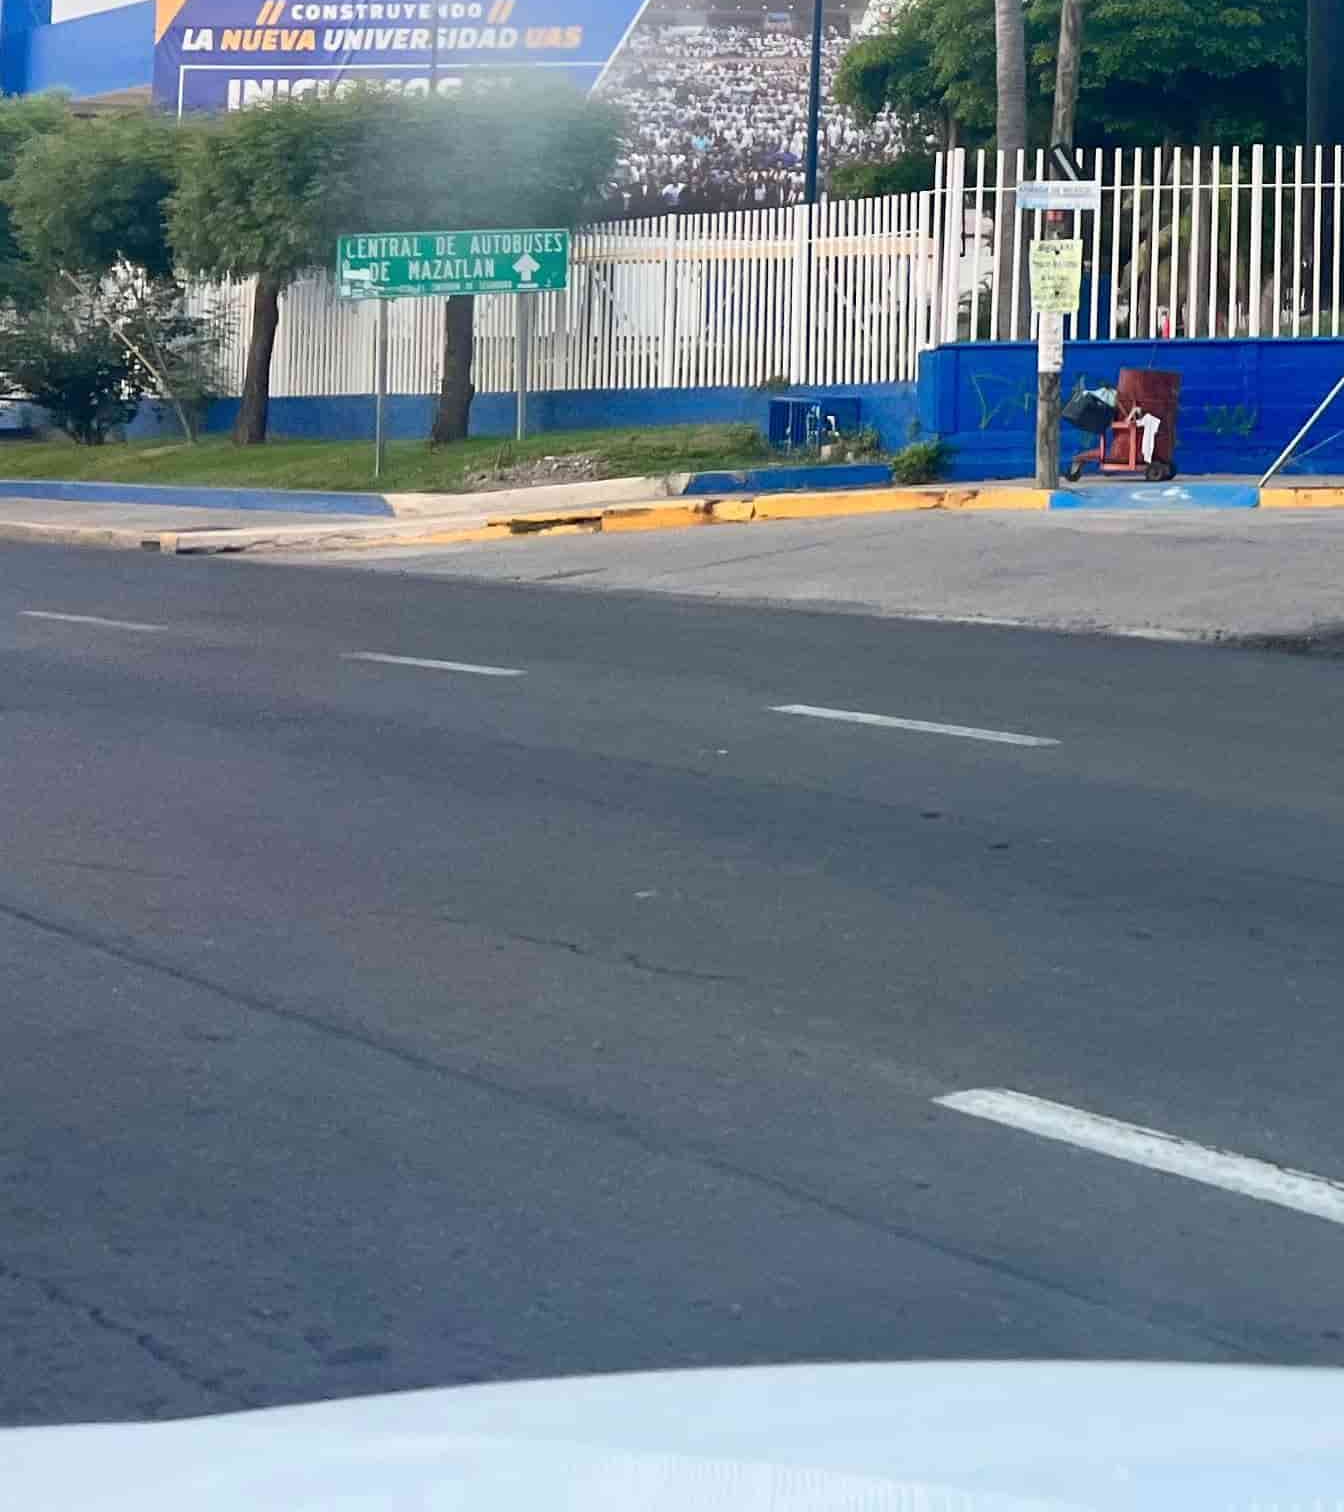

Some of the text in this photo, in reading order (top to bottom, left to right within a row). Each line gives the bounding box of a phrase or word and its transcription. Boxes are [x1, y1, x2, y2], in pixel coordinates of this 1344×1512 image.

[182, 26, 581, 51] LA NUEVA UNIVERSIDAD UAS
[346, 233, 563, 259] CENTRAL DE AUTOBUSES
[369, 258, 495, 281] DE MAZATLAN
